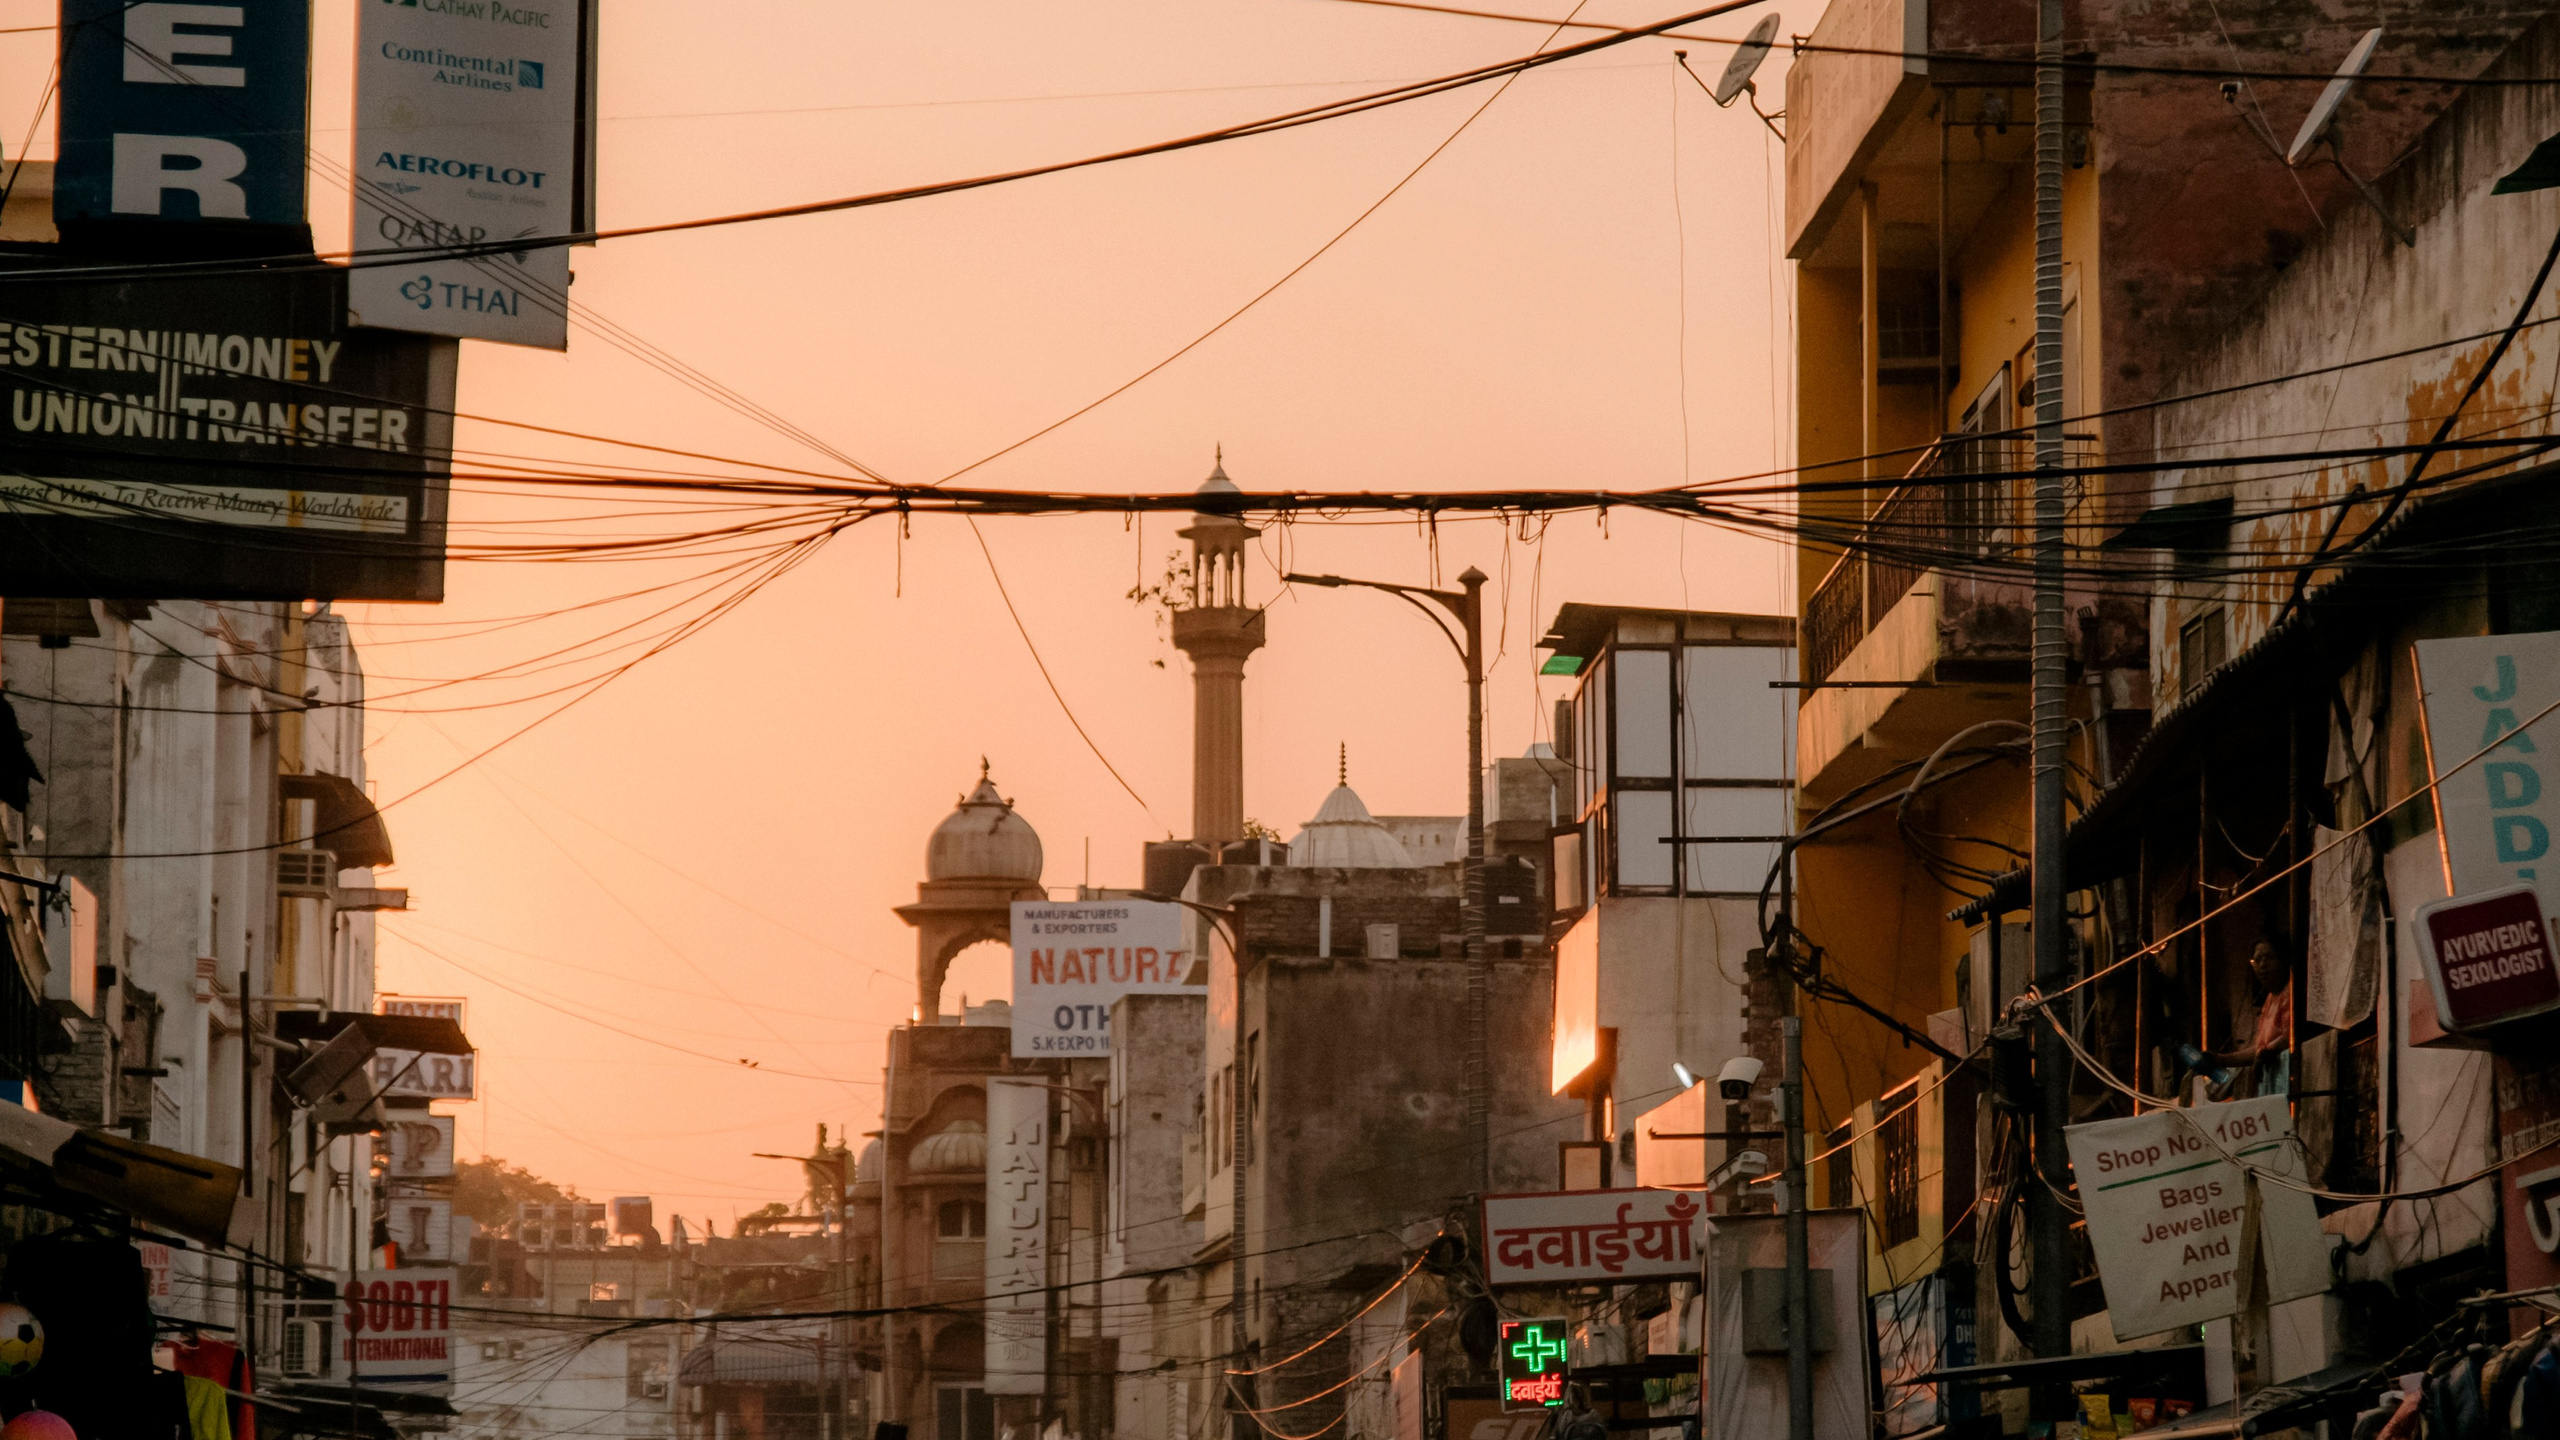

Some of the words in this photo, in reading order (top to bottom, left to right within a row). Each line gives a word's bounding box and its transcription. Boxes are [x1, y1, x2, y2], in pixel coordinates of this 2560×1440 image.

[423, 0, 485, 19] CATHAY
[491, 1, 550, 29] PACIFIC
[381, 41, 514, 77] Continental
[432, 69, 513, 93] Airlines
[375, 151, 547, 189] AEROFLOT
[438, 280, 519, 317] THAI
[183, 332, 343, 384] MONEY
[12, 387, 157, 439] UNION
[179, 396, 409, 453] TRANSFER
[114, 485, 135, 502] To
[143, 487, 209, 512] Receive
[213, 492, 284, 522] Money
[2472, 654, 2551, 881] JADD
[1024, 908, 1129, 920] MANUFACTURERS
[1031, 922, 1041, 935] &
[1044, 922, 1118, 934] EXPORTERS
[2442, 920, 2540, 965] AYURVEDIC
[2448, 948, 2547, 991] SEXOLOGIST
[375, 1056, 473, 1093] HARI
[2096, 1145, 2161, 1174] Shop
[2216, 1112, 2271, 1143] 1081
[2159, 1180, 2223, 1210] Bags
[2182, 1234, 2231, 1266] And
[343, 1280, 449, 1332] SOBTI
